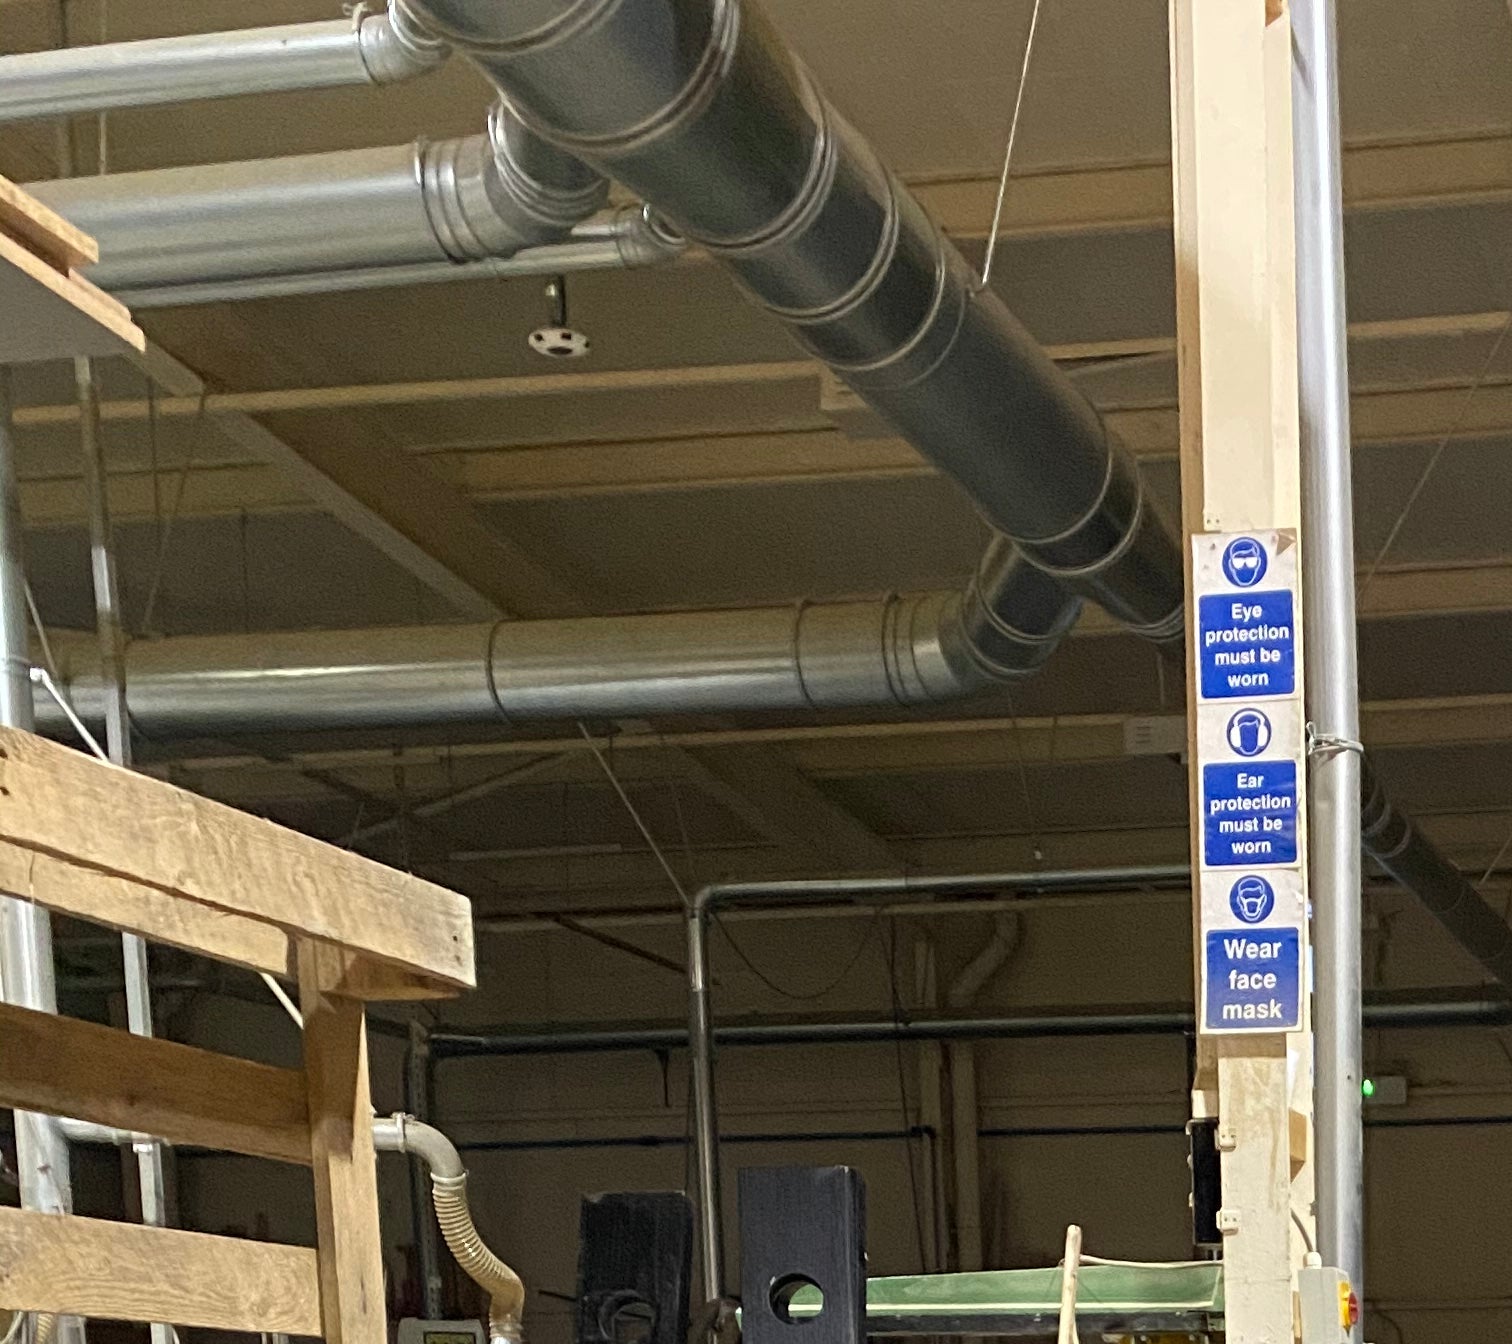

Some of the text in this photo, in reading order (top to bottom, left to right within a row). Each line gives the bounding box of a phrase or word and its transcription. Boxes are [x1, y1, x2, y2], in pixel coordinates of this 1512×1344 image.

[1231, 602, 1263, 623] Eye
[1205, 625, 1290, 647] protection
[1214, 647, 1282, 666] must be
[1227, 671, 1270, 688] worn
[1236, 772, 1264, 789] Ear
[1210, 793, 1291, 813] protection
[1219, 816, 1283, 833] must be
[1231, 839, 1272, 855] worn
[1223, 938, 1283, 960] Wear
[1228, 969, 1278, 990] face
[1222, 998, 1283, 1021] mask
